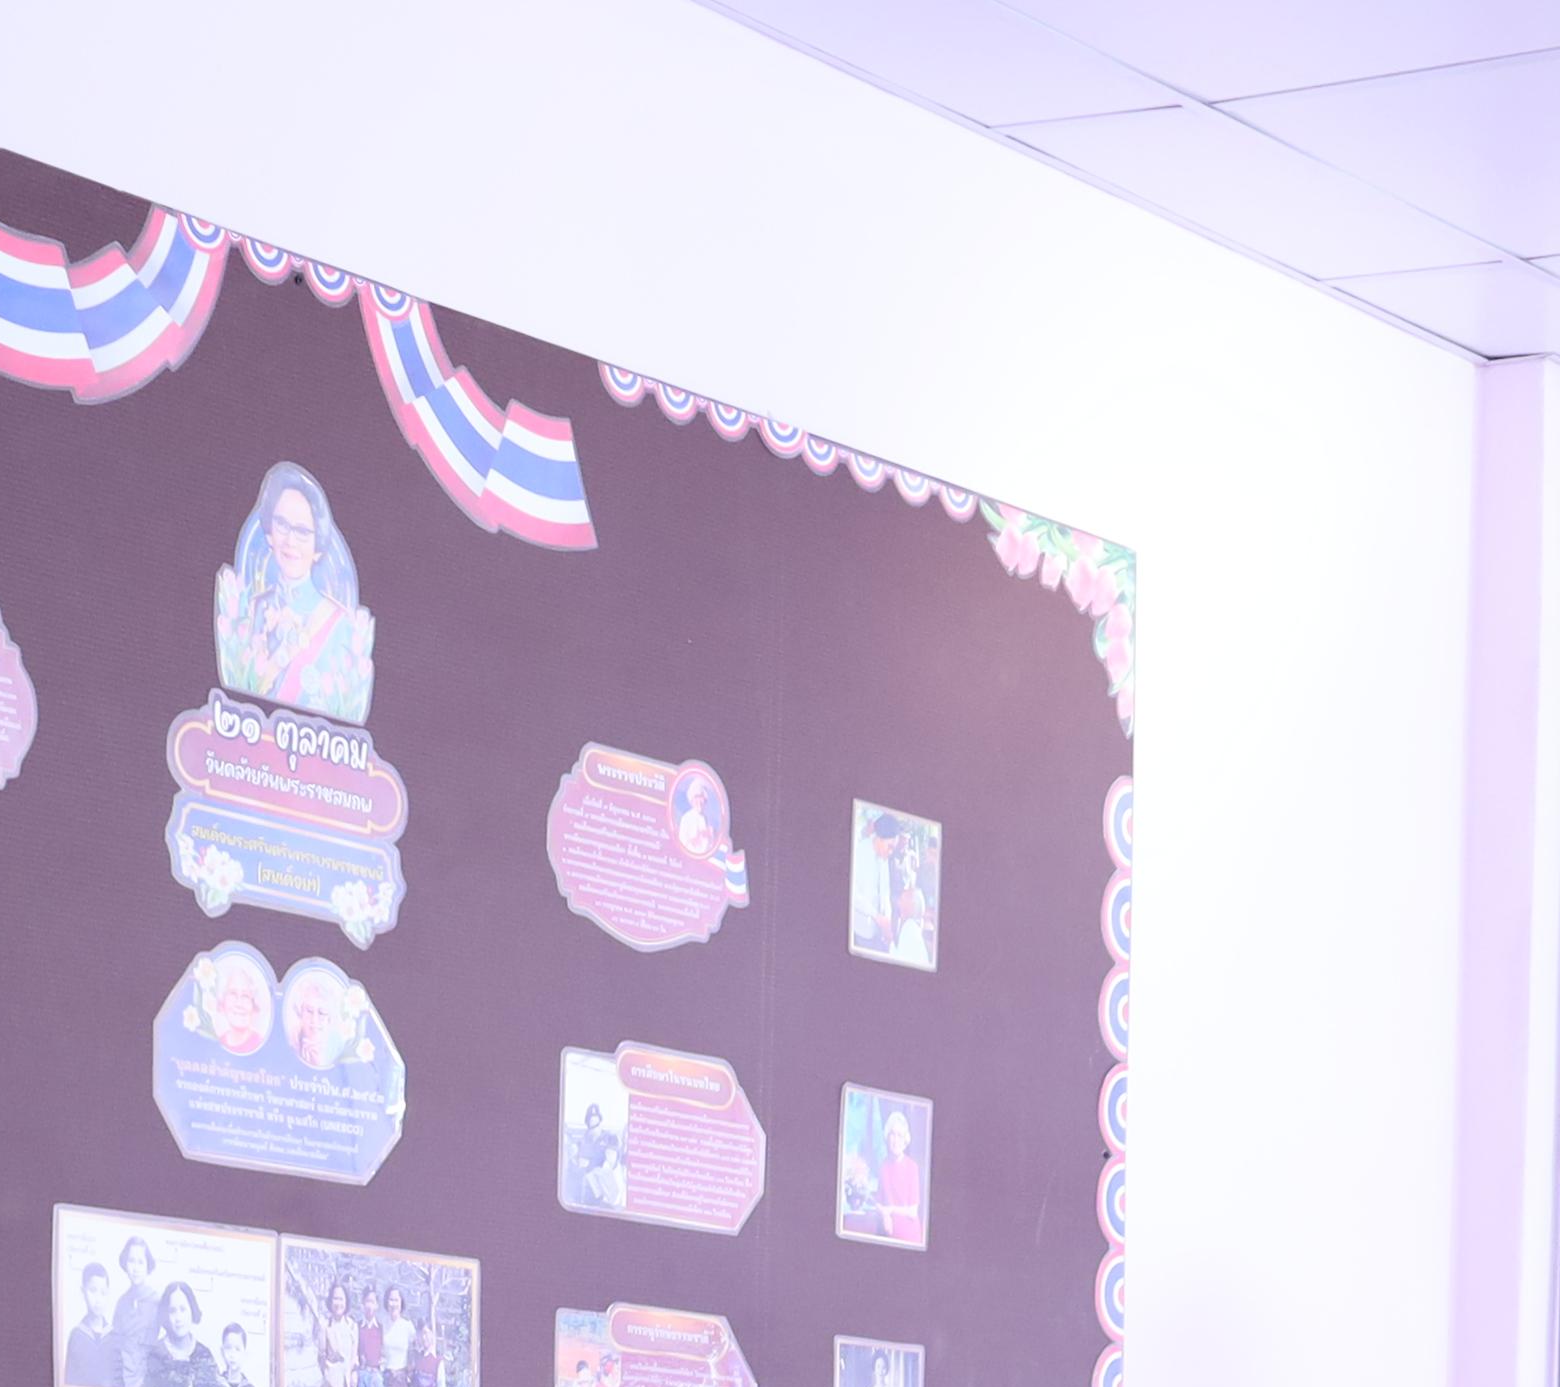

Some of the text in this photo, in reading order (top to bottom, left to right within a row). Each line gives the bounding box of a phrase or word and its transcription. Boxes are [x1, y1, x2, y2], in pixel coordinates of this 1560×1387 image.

[214, 700, 368, 771] ๒๑ ตุลาคม
[205, 750, 373, 813] วันคล้ายวันพระราชสมภพ
